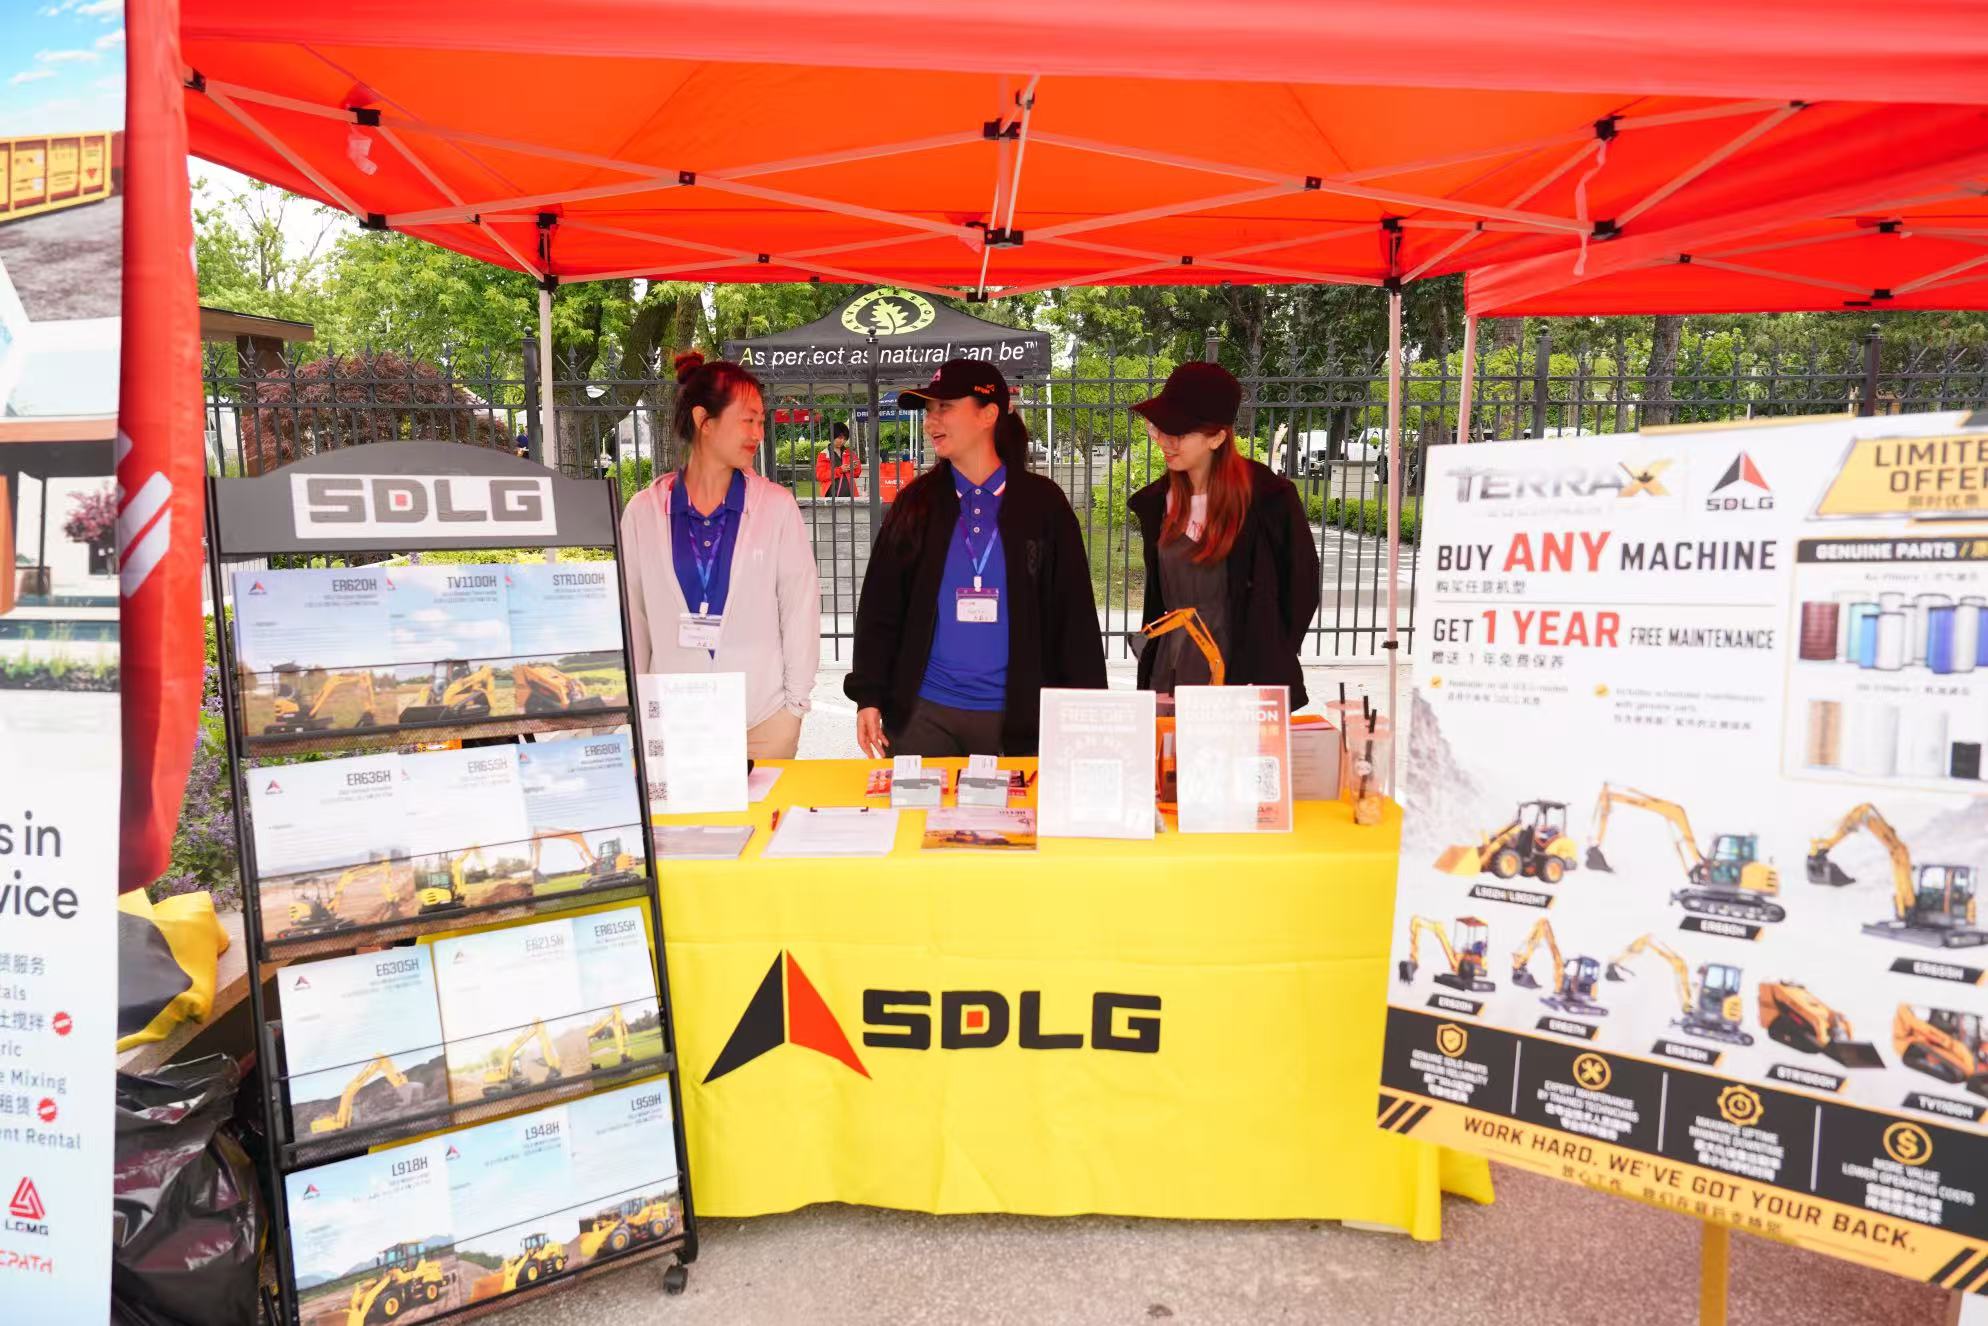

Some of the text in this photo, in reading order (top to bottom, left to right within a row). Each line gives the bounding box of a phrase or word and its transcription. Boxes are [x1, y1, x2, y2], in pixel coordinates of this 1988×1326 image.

[739, 347, 765, 366] As
[879, 342, 951, 364] natural
[306, 478, 545, 524] SDLG
[1706, 496, 1774, 511] SDLG
[1436, 531, 1777, 573] BUY ANY MACHINE
[1815, 543, 1892, 560] GENUINE
[1895, 542, 1957, 560] PARTS
[447, 575, 498, 590] TV1100H
[1433, 609, 1775, 650] GET 1 YEAR FREE MAINTENANCE
[346, 770, 392, 787] ER636H
[24, 810, 62, 858] in
[862, 987, 1163, 1054] SDLG
[10, 1070, 67, 1095] Mixing
[25, 1127, 81, 1150] Rental
[524, 1120, 560, 1141] L948H
[391, 1156, 428, 1178] L918H
[1463, 1115, 1524, 1144] WORK
[1531, 1134, 1599, 1167] HARD.
[1608, 1153, 1686, 1189] WE'VE
[1691, 1175, 1742, 1204] GOT
[1751, 1189, 1823, 1227] YOUR
[1831, 1212, 1918, 1254] BACK.
